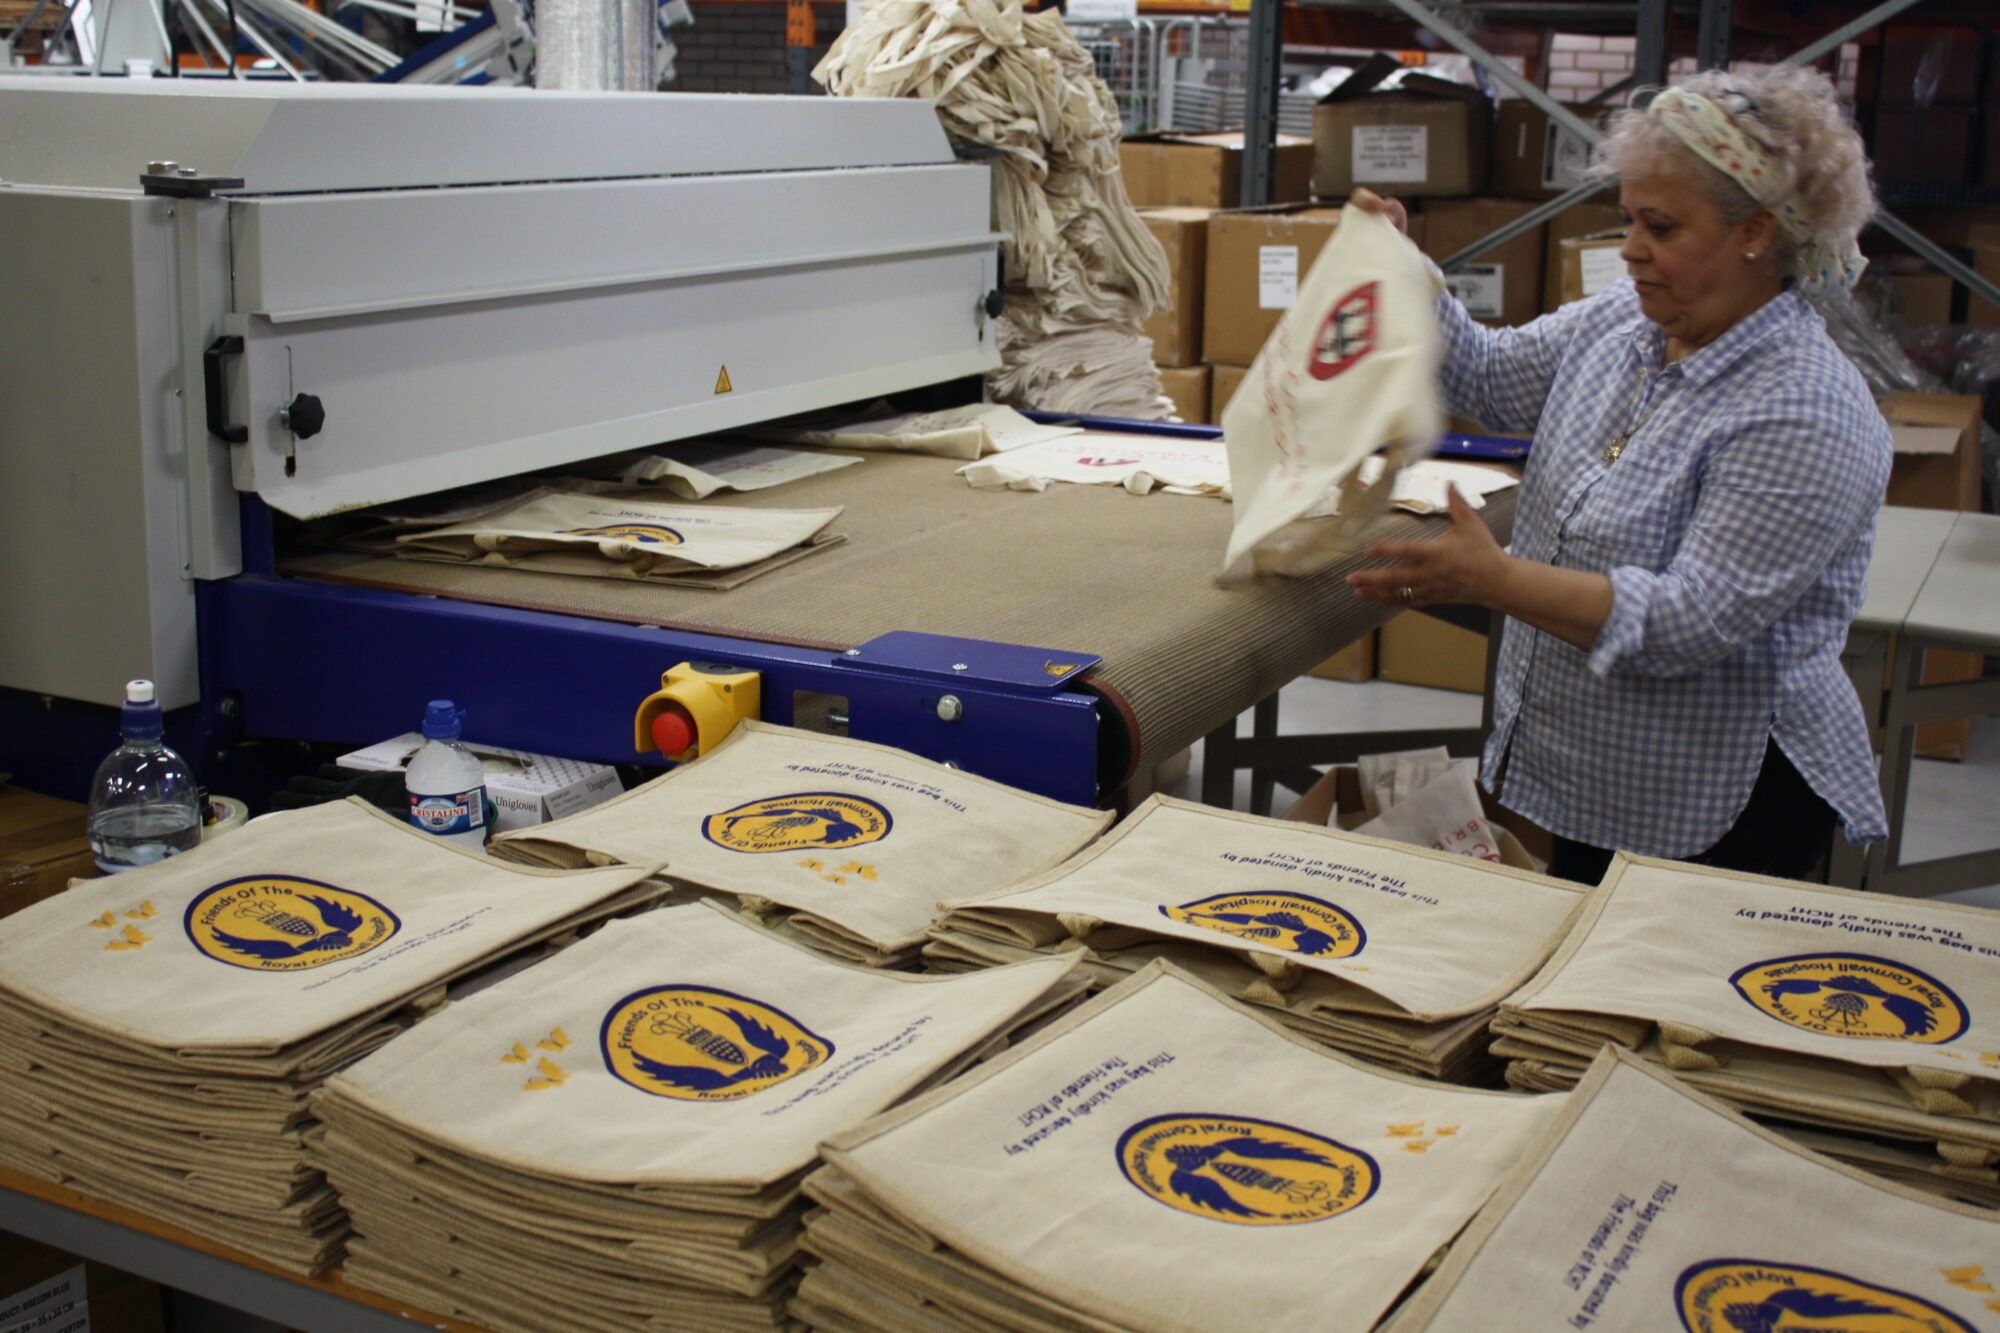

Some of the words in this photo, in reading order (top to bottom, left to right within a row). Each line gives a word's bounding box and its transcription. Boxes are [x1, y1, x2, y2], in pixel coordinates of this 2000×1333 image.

[800, 764, 850, 778] donated
[853, 772, 889, 786] kindly
[917, 788, 941, 800] bag
[495, 795, 538, 813] Unigloves
[760, 798, 824, 811] Hospitals
[825, 799, 874, 823] Cornwall
[943, 799, 967, 813] This
[411, 807, 466, 818] CRISTALINE
[1219, 852, 1238, 862] by
[1238, 856, 1298, 871] donated
[1266, 851, 1305, 864] RCHT
[1300, 866, 1344, 882] kindly
[1327, 862, 1378, 880] Friends
[1348, 876, 1376, 889] was
[1380, 875, 1407, 889] The
[1380, 885, 1408, 898] bag
[201, 894, 238, 926] Friends
[236, 886, 258, 900] Of
[260, 885, 293, 897] The
[1209, 897, 1278, 912] Hospitals
[1411, 894, 1439, 906] This
[1280, 900, 1338, 924] Cornwall
[1735, 908, 1757, 919] by
[1760, 911, 1834, 928] donated
[1788, 906, 1834, 919] RCHT
[1837, 922, 1893, 937] kindly
[1863, 916, 1927, 932] Friends
[1898, 931, 1934, 942] was
[1931, 927, 1964, 940] The
[1939, 937, 1973, 952] bag
[260, 959, 307, 970] Royal
[1763, 962, 1834, 978] Hospitals
[1838, 963, 1913, 986] Cornwall
[1908, 984, 1947, 1009] Royal
[1771, 1002, 1799, 1021] The
[617, 1008, 649, 1050] Friends
[646, 999, 670, 1012] Of
[667, 997, 705, 1008] The
[1801, 1020, 1828, 1031] Of
[1101, 1055, 1129, 1071] The
[1147, 1051, 1176, 1068] This
[1124, 1065, 1154, 1080] bag
[1061, 1067, 1108, 1098] Friends
[1104, 1076, 1130, 1092] was
[697, 1087, 748, 1100] Royal
[1047, 1094, 1063, 1110] of
[1067, 1090, 1112, 1118] kindly
[1017, 1103, 1053, 1127] RCHT
[1200, 1123, 1252, 1136] Royal
[1139, 1124, 1198, 1152] Cornwall
[1003, 1144, 1029, 1156] by
[1652, 1180, 1678, 1203] This
[1611, 1193, 1636, 1214] The
[1636, 1201, 1665, 1223] bag
[1587, 1212, 1623, 1251] Friends
[1626, 1221, 1649, 1244] was
[1580, 1250, 1597, 1266] of
[1603, 1243, 1641, 1273] kindly
[1737, 1268, 1796, 1287] Royal
[23, 1290, 52, 1312] BRECON
[53, 1280, 71, 1297] BLUE
[1567, 1313, 1595, 1330] by
